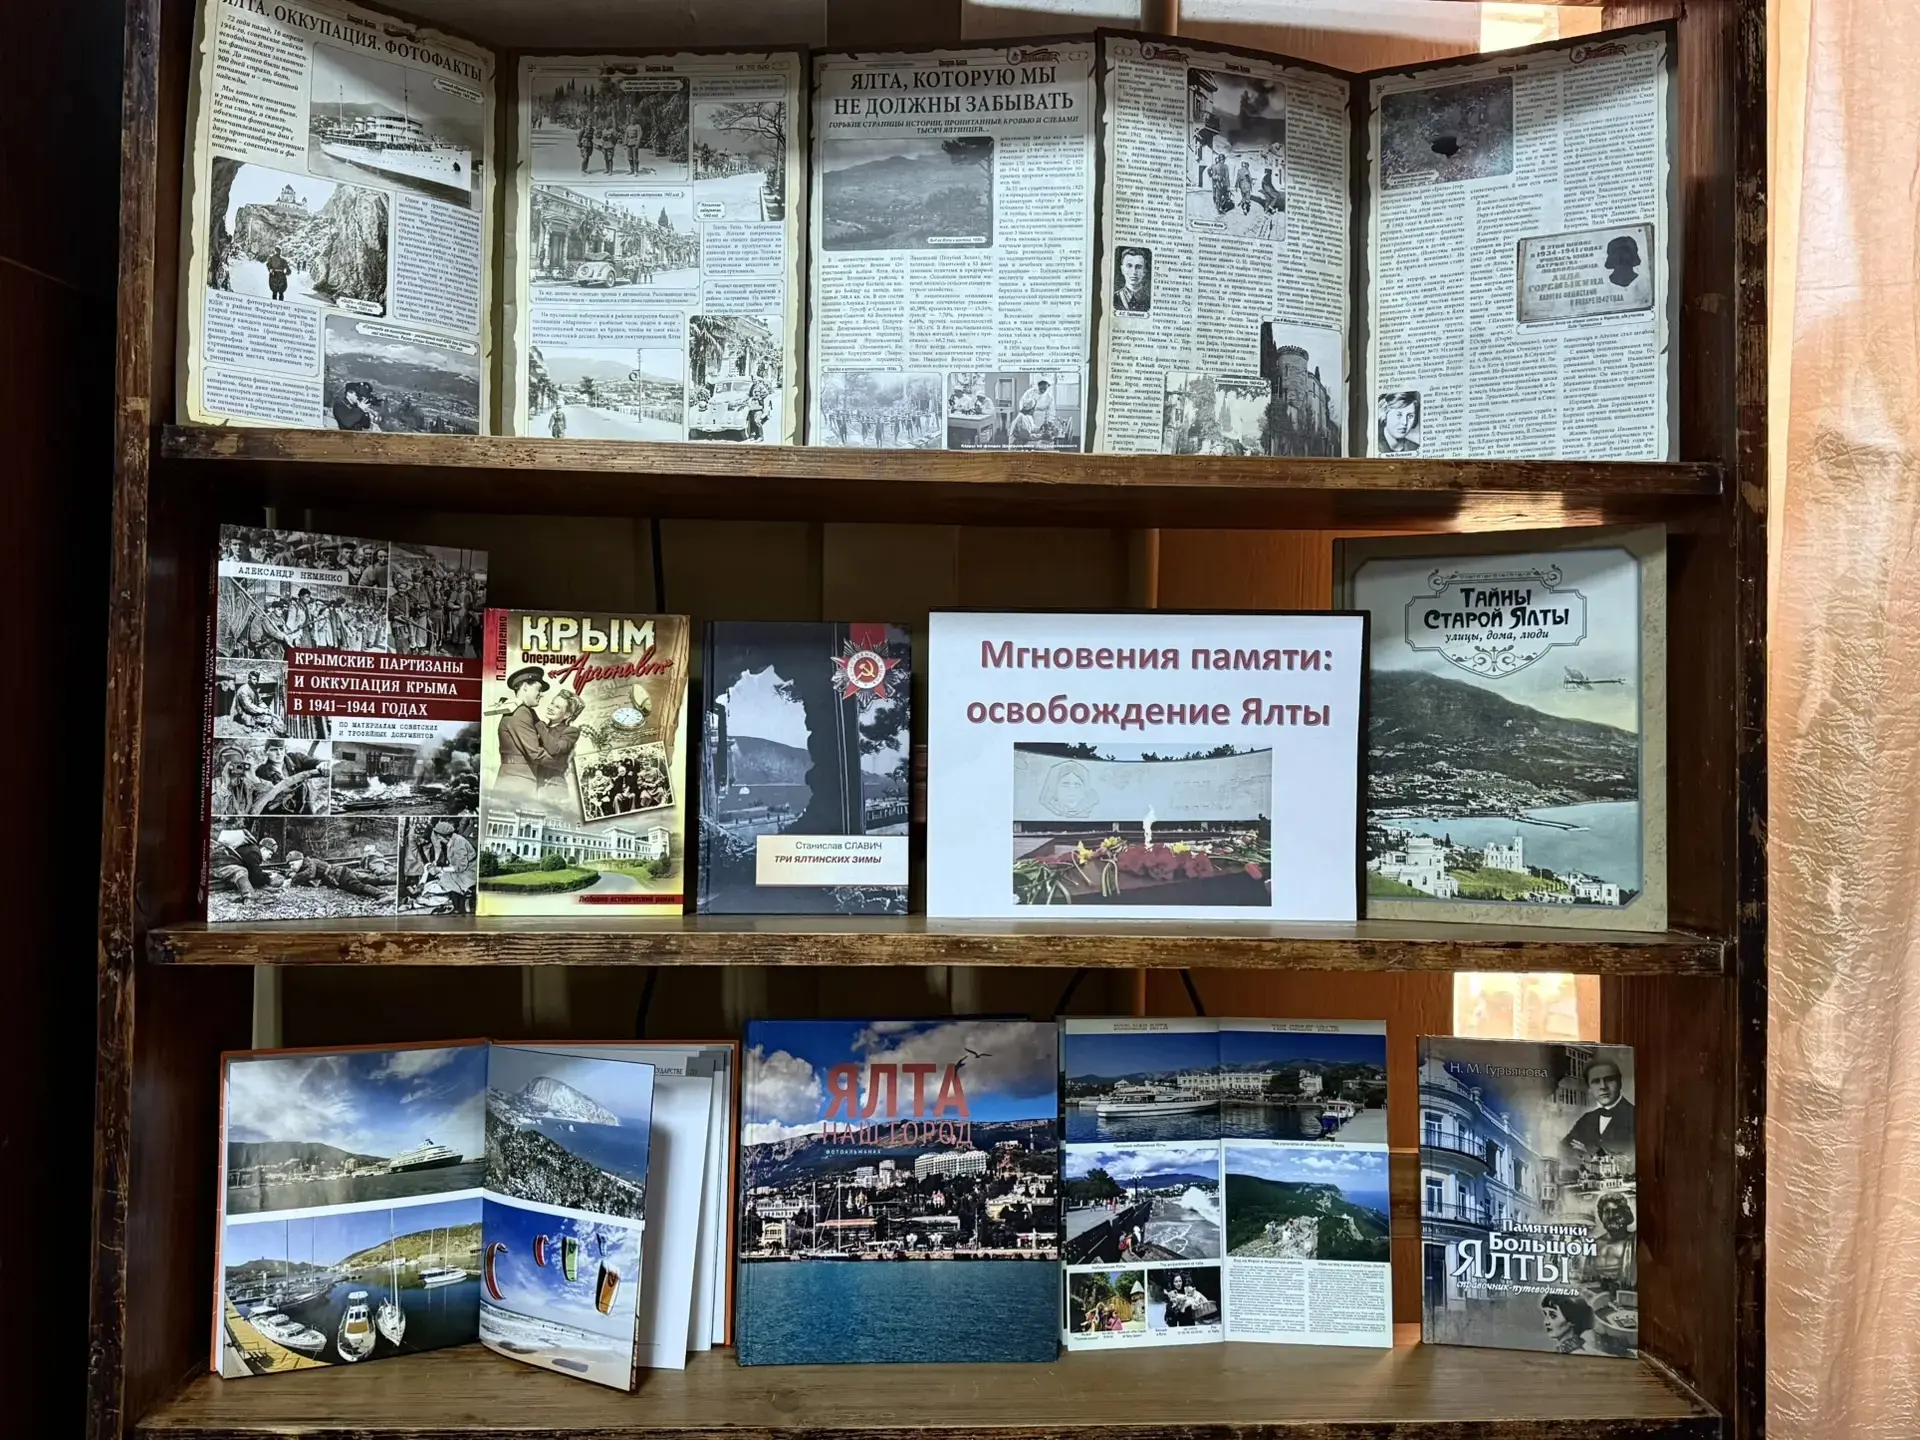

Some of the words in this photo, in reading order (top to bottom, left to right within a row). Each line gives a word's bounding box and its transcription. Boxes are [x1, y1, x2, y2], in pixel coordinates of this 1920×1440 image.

[274, 6, 380, 50] ОККУПАЦИЯ.
[386, 40, 482, 82] ФОТОФАКТЫ
[850, 72, 908, 92] ЯЛТА,
[914, 70, 1015, 88] КОТОРУЮ
[1020, 66, 1056, 85] МЫ
[834, 98, 862, 115] НЕ
[866, 97, 960, 118] ДОЛЖНЫ
[966, 92, 1073, 113] ЗАБЫВАТЬ
[238, 566, 295, 579] АЛЕКСАНДР
[300, 572, 343, 583] НЕМЕНКО
[522, 616, 656, 653] КРЫМ
[1445, 632, 1483, 644] улицы,
[1486, 631, 1516, 642] дома,
[1520, 629, 1549, 640] люди
[294, 652, 374, 669] КРЫМСКИЕ
[380, 657, 464, 674] ПАРТИЗАНЫ
[522, 652, 577, 665] Операция
[980, 640, 1180, 670] Мгновения
[1192, 647, 1333, 672] памяти:
[548, 645, 674, 695] «Аргонавт»
[294, 675, 304, 688] И
[310, 675, 400, 694] ОККУПАЦИЯ
[406, 680, 457, 695] КРЫМА
[294, 699, 302, 711] В
[382, 702, 428, 716] ГОДАХ
[966, 694, 1231, 731] освобождение
[1240, 698, 1331, 726] Ялты
[795, 841, 843, 850] Станислав
[844, 841, 882, 850] СЛАВИЧ
[794, 856, 850, 864] ЯЛТИНСКИХ
[852, 856, 882, 864] ЗИМЫ
[1450, 1062, 1463, 1073] Н.
[1466, 1064, 1482, 1074] М.
[1486, 1064, 1548, 1078] Гурьянова
[825, 1062, 970, 1118] ЯЛТА
[822, 1121, 878, 1145] НАШ
[890, 1121, 973, 1149] ГОРОД
[1457, 1281, 1580, 1296] справочник-путеводитель
